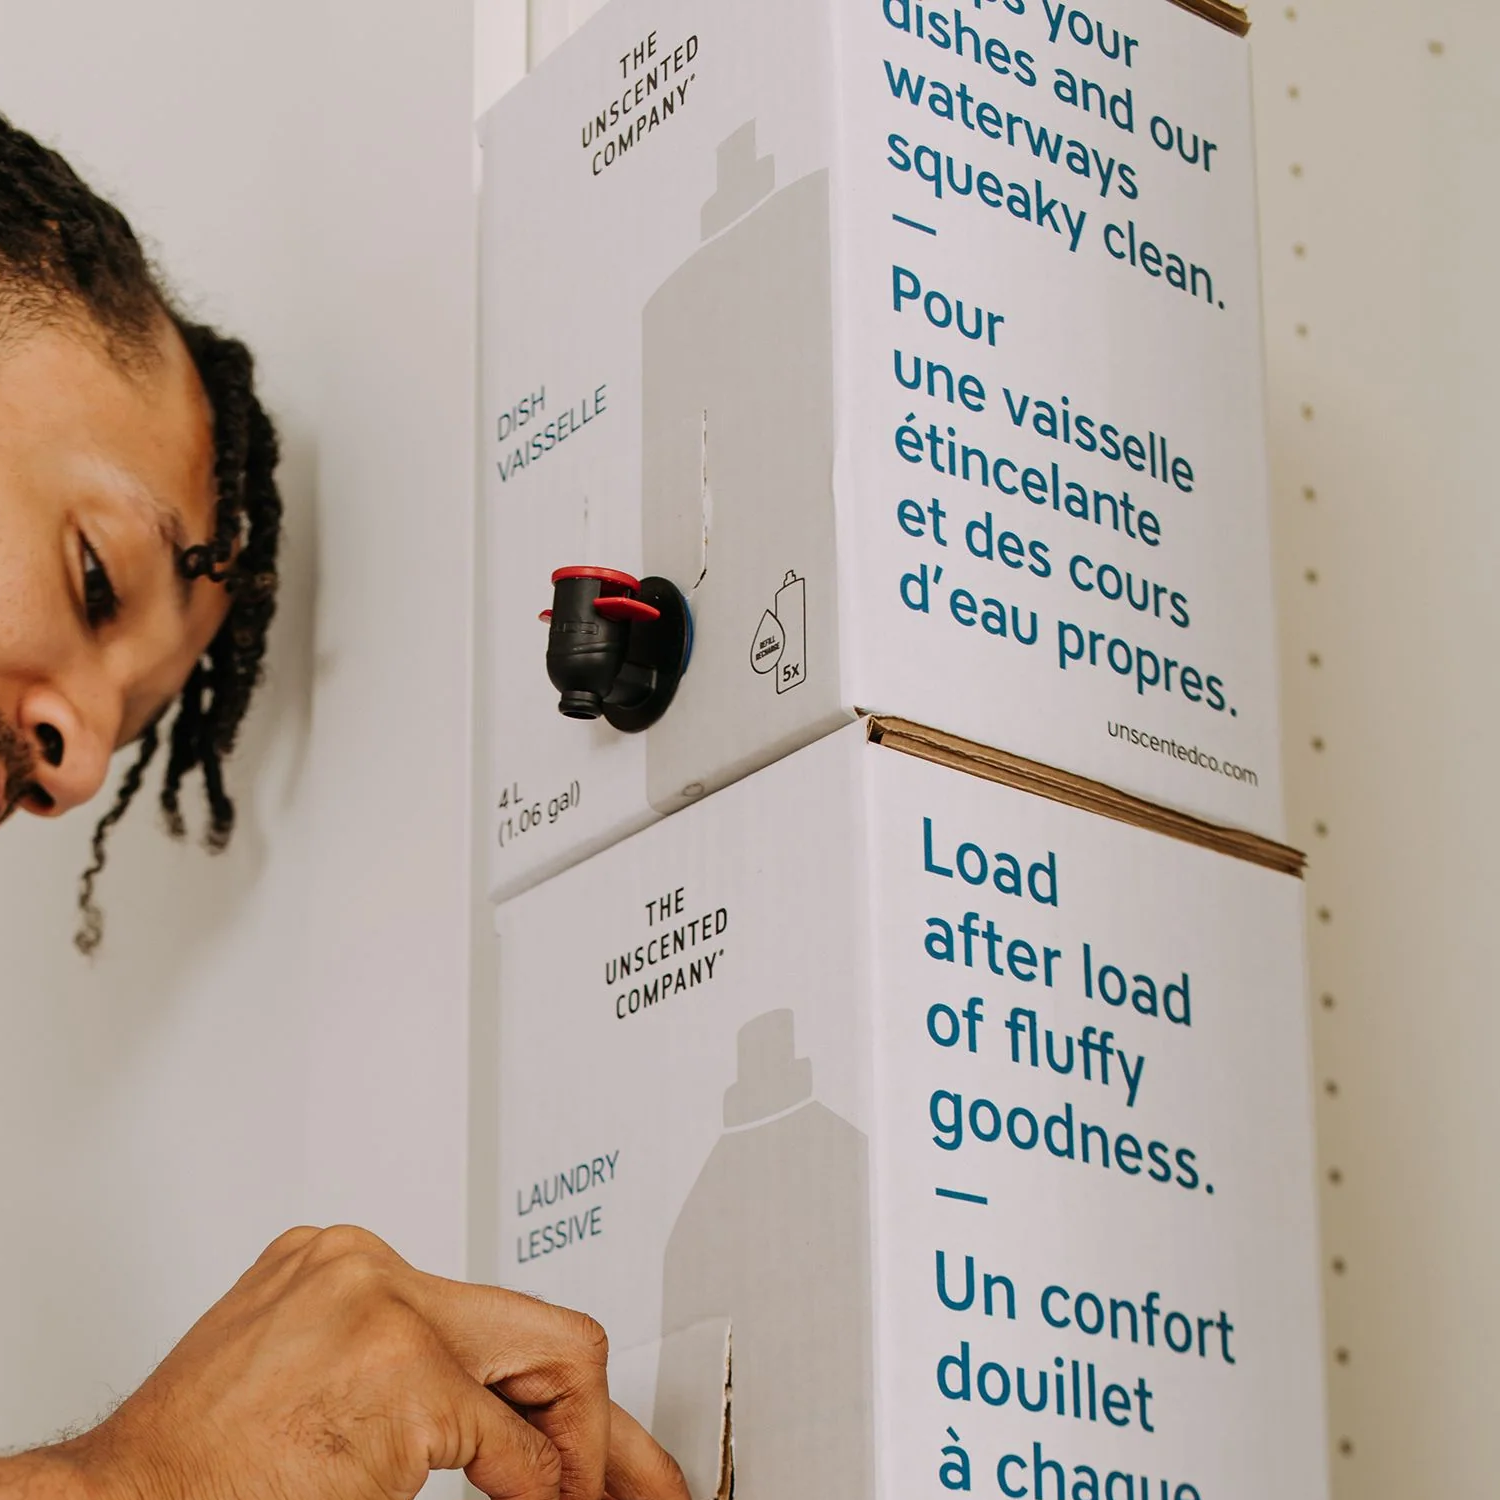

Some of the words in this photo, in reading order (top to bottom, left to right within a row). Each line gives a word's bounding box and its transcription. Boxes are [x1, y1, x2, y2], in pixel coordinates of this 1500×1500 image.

[620, 30, 657, 79] THE
[1042, 0, 1139, 67] your
[582, 35, 698, 148] UNSCENTED
[882, 0, 1037, 87] dishes
[1054, 68, 1134, 133] and
[1150, 116, 1217, 172] our
[883, 59, 1139, 200] waterways
[887, 134, 1087, 252] squeaky
[1104, 220, 1225, 310] clean.
[892, 265, 1004, 347] Pour
[498, 385, 545, 442] DISH
[498, 384, 607, 482] VAISSELLE
[894, 350, 986, 412] une
[1002, 388, 1194, 493] vaisselle
[894, 412, 1161, 547] étincelante
[897, 497, 948, 547] et
[965, 511, 1052, 578] des
[1068, 554, 1191, 628] cours
[783, 663, 799, 682] 5x
[1058, 620, 1237, 718] propres.
[499, 788, 508, 809] 4
[514, 782, 523, 804] L
[1108, 721, 1259, 787] unscentedco.com
[498, 802, 542, 848] (1.06
[548, 780, 580, 824] gal)
[646, 887, 684, 927] THE
[923, 816, 1058, 907] Load
[606, 908, 728, 985] UNSCENTED
[924, 912, 1061, 987] after
[1083, 943, 1191, 1027] load
[926, 997, 984, 1053] of
[1005, 1008, 1145, 1107] fluffy
[518, 1150, 620, 1216] LAUNDRY
[930, 1089, 1214, 1195] goodness.
[518, 1206, 602, 1264] LESSIVE
[936, 1250, 1016, 1320] Un
[1040, 1292, 1236, 1364] confort
[937, 1341, 1155, 1433] douillet
[938, 1426, 971, 1491] à
